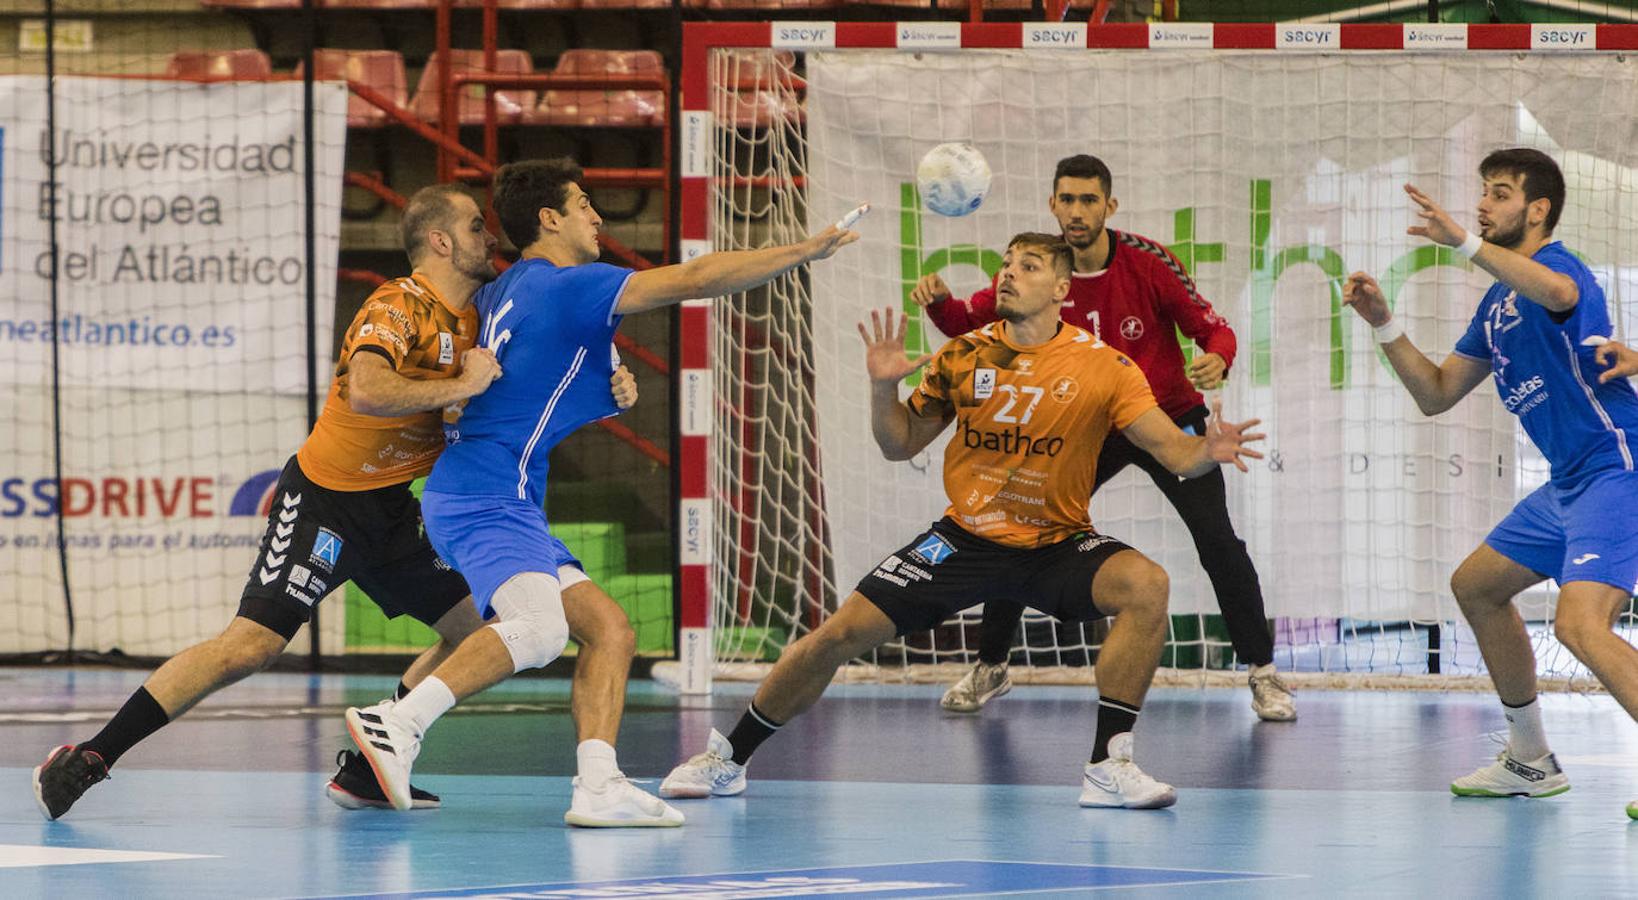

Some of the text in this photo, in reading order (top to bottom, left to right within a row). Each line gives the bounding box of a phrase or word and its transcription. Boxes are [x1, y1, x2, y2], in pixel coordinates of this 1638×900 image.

[1285, 30, 1331, 43] sacyr
[1540, 31, 1587, 44] sacyr
[39, 128, 296, 172] Universidad
[38, 181, 222, 234] Europea
[35, 243, 302, 286] del Atlántico
[993, 384, 1045, 424] 27
[964, 419, 1064, 458] bathco
